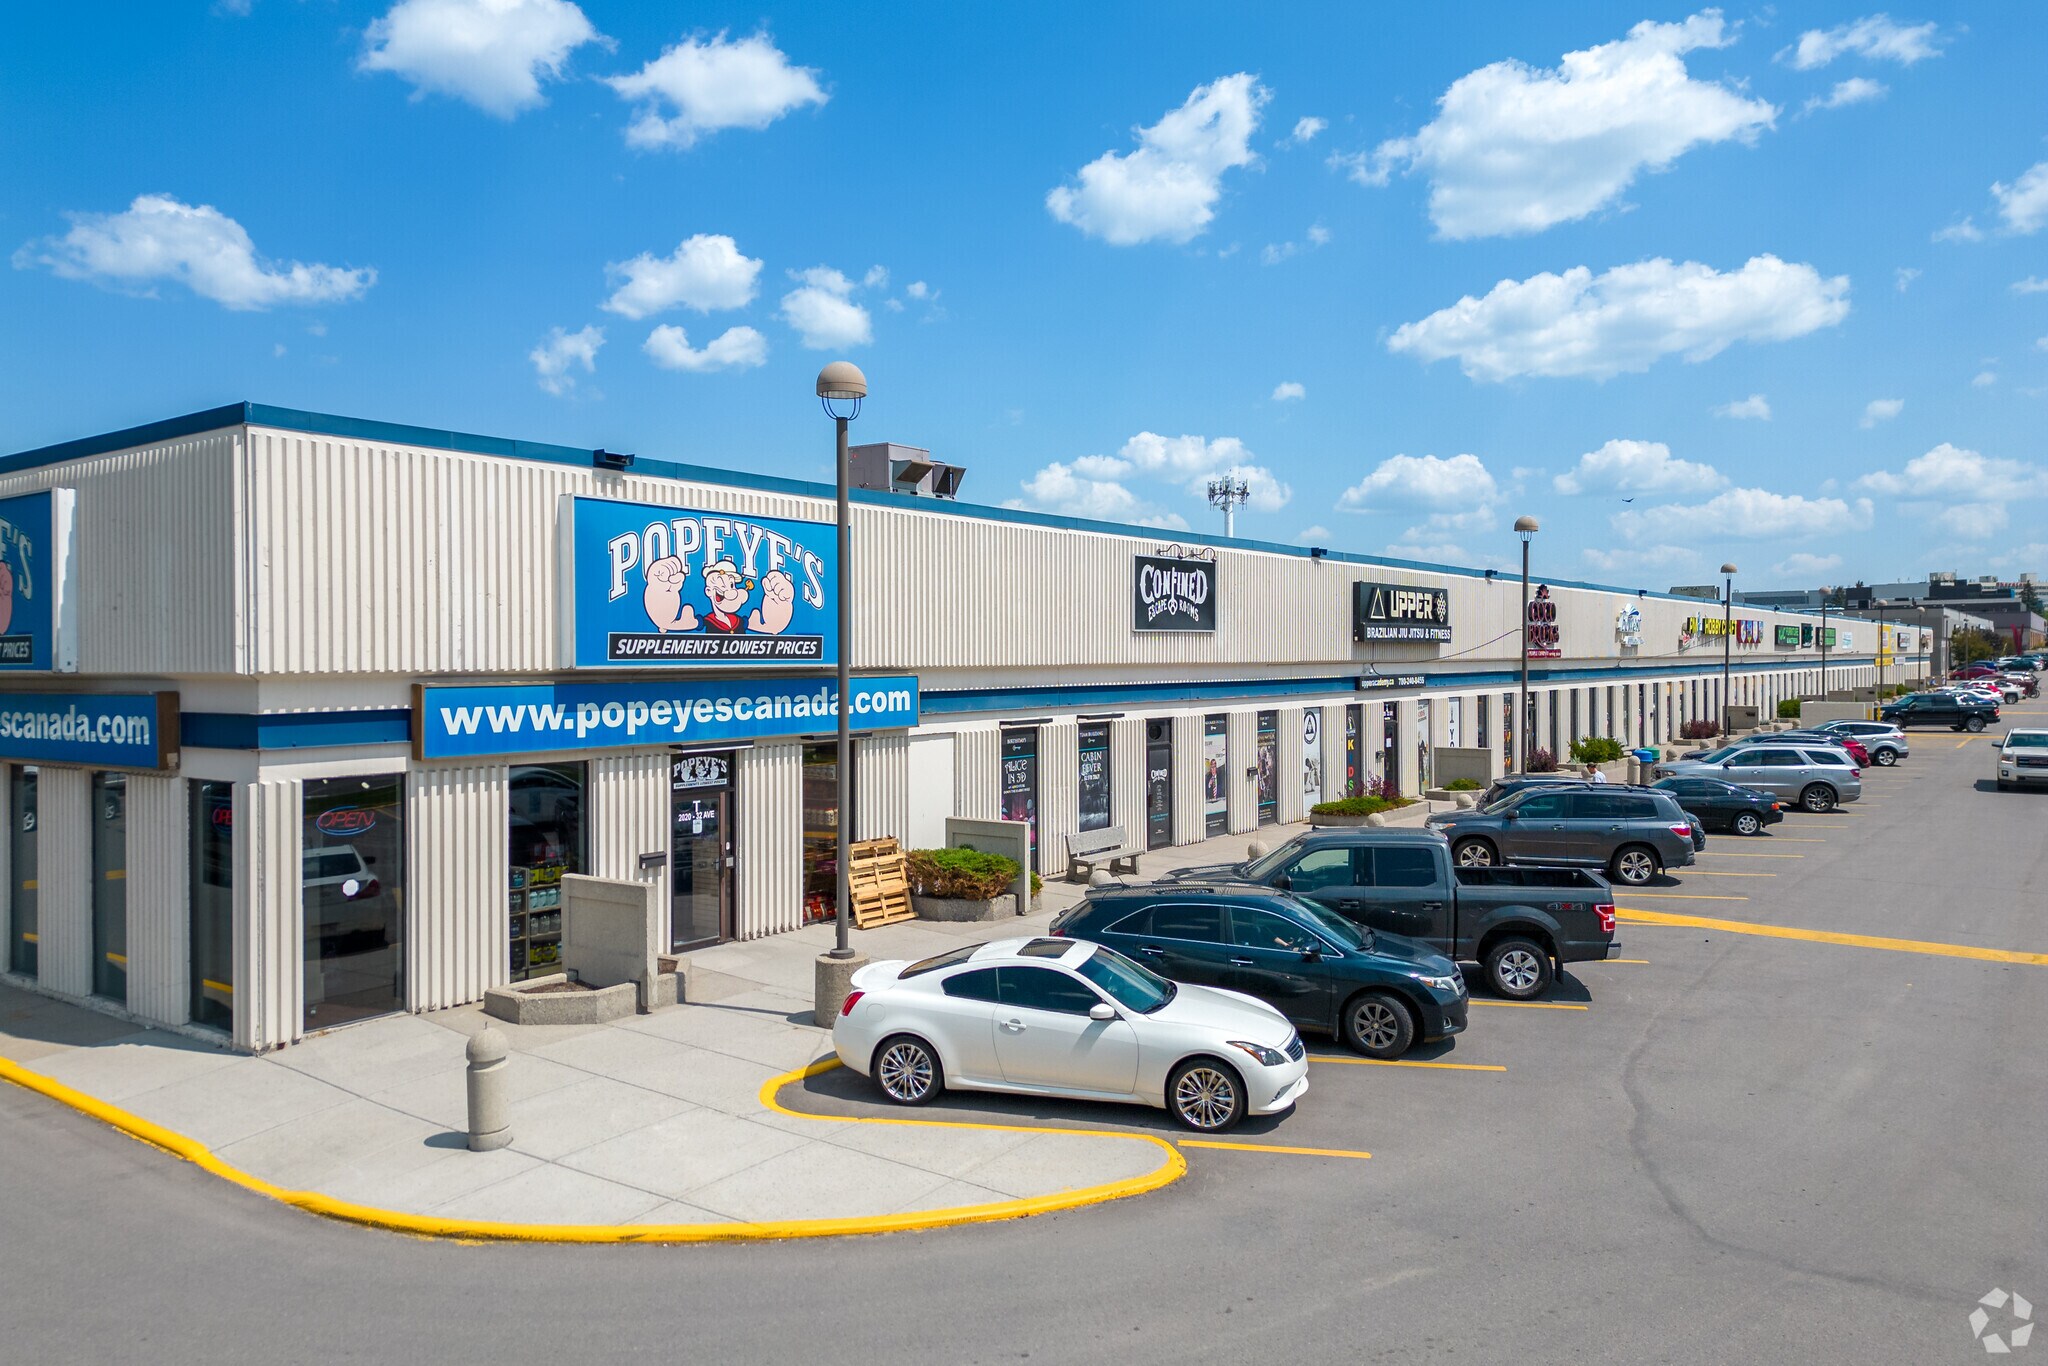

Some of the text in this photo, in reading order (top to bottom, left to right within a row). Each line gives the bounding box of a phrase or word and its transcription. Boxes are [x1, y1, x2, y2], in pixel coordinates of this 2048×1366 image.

[608, 517, 825, 610] POPEYE'S
[1140, 564, 1208, 605] CONFINED
[1148, 598, 1199, 622] ESCAPE ROOMS
[1390, 590, 1433, 619] UPPER
[1366, 627, 1451, 640] BRAZILIAN JIU JITSU & FITNESS
[1704, 618, 1721, 635] HOBBY
[2, 641, 30, 658] PRICES
[615, 638, 818, 655] SUPPLEMENTS LOWEST PRICES
[0, 704, 150, 745] scanada.com
[1081, 751, 1103, 762] CABIN
[1347, 738, 1355, 791] KIDS
[673, 756, 728, 778] POPEYE'S
[693, 800, 701, 813] T
[318, 810, 376, 828] OPEN
[678, 812, 692, 822] 2020
[695, 811, 703, 820] 32
[703, 810, 715, 819] AVE
